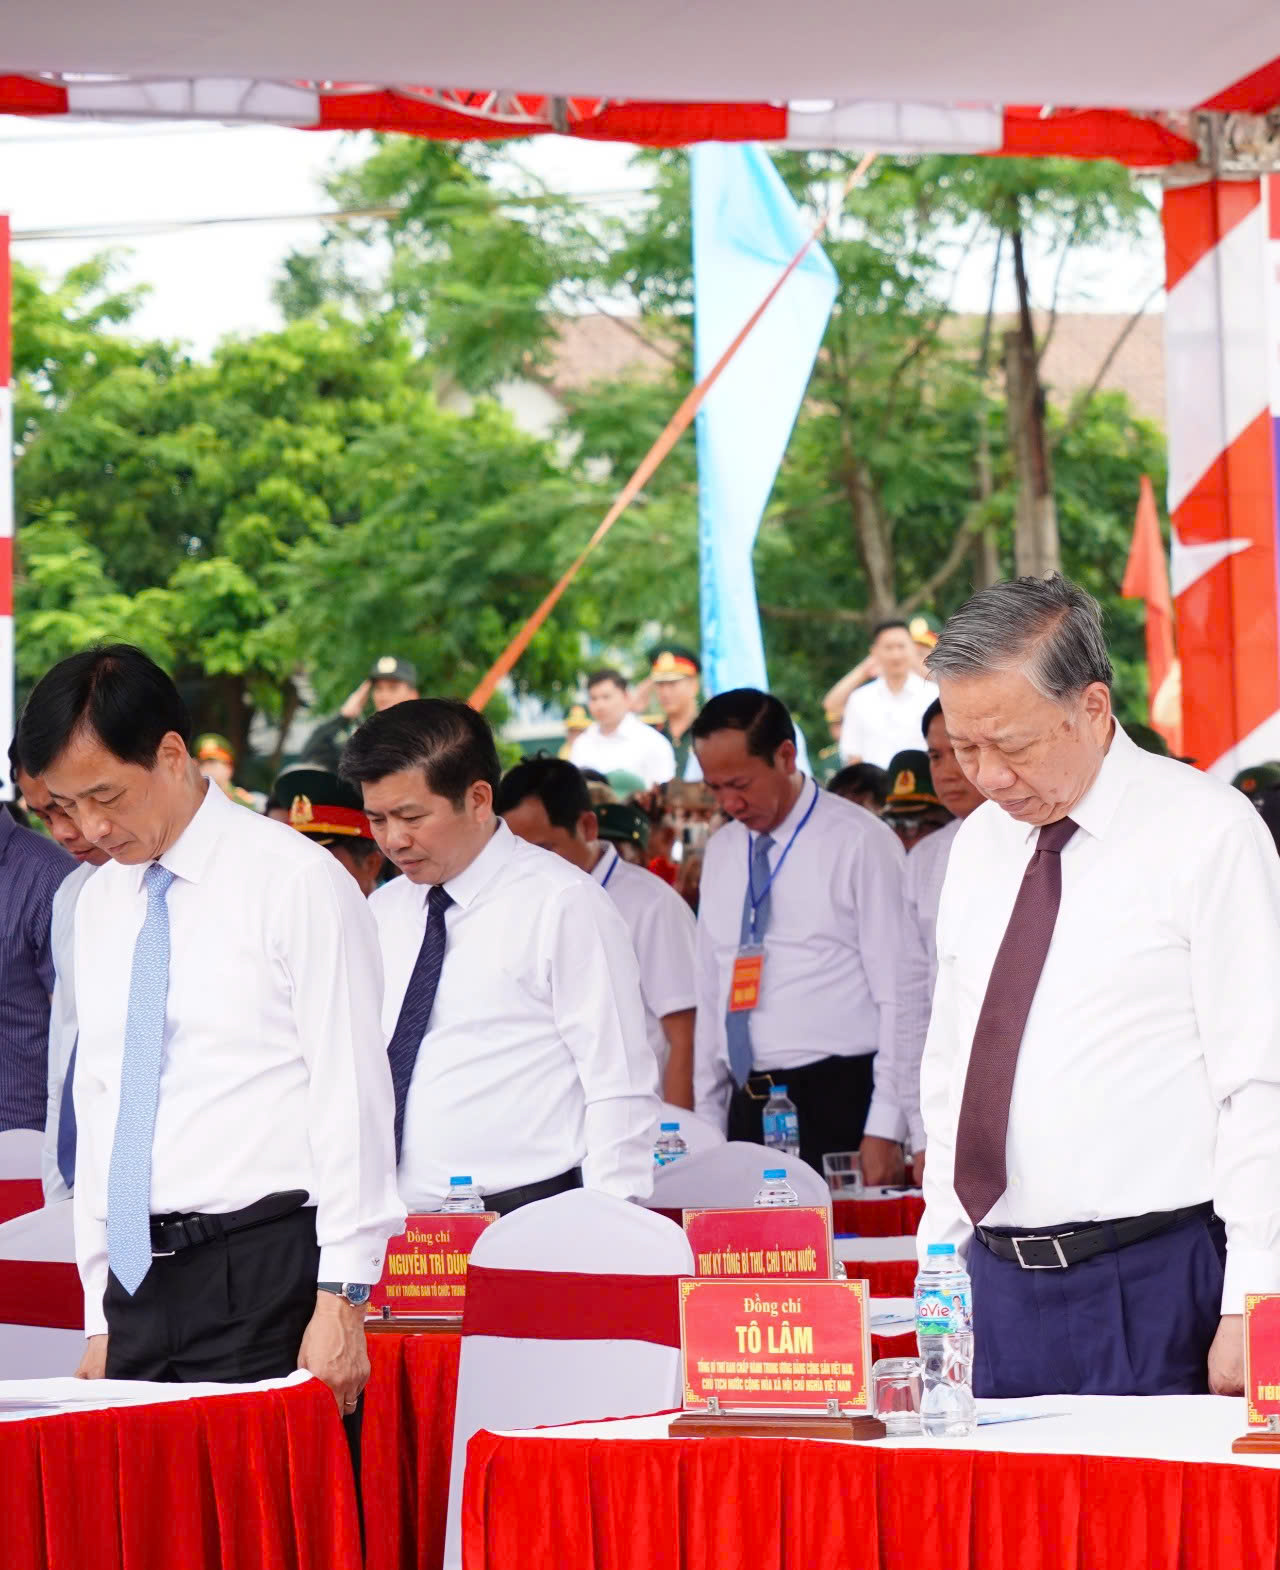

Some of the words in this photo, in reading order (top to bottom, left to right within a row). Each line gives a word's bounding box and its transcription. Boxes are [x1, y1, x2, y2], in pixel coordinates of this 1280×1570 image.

[407, 1227, 433, 1245] Đồng
[435, 1230, 450, 1242] chí
[388, 1247, 428, 1275] NGUYỄN
[429, 1249, 444, 1275] TRÍ
[447, 1250, 470, 1275] DŨN
[744, 1293, 778, 1317] Đồng
[781, 1297, 801, 1313] chí
[735, 1320, 762, 1354] TÔ
[768, 1320, 813, 1354] LÂM
